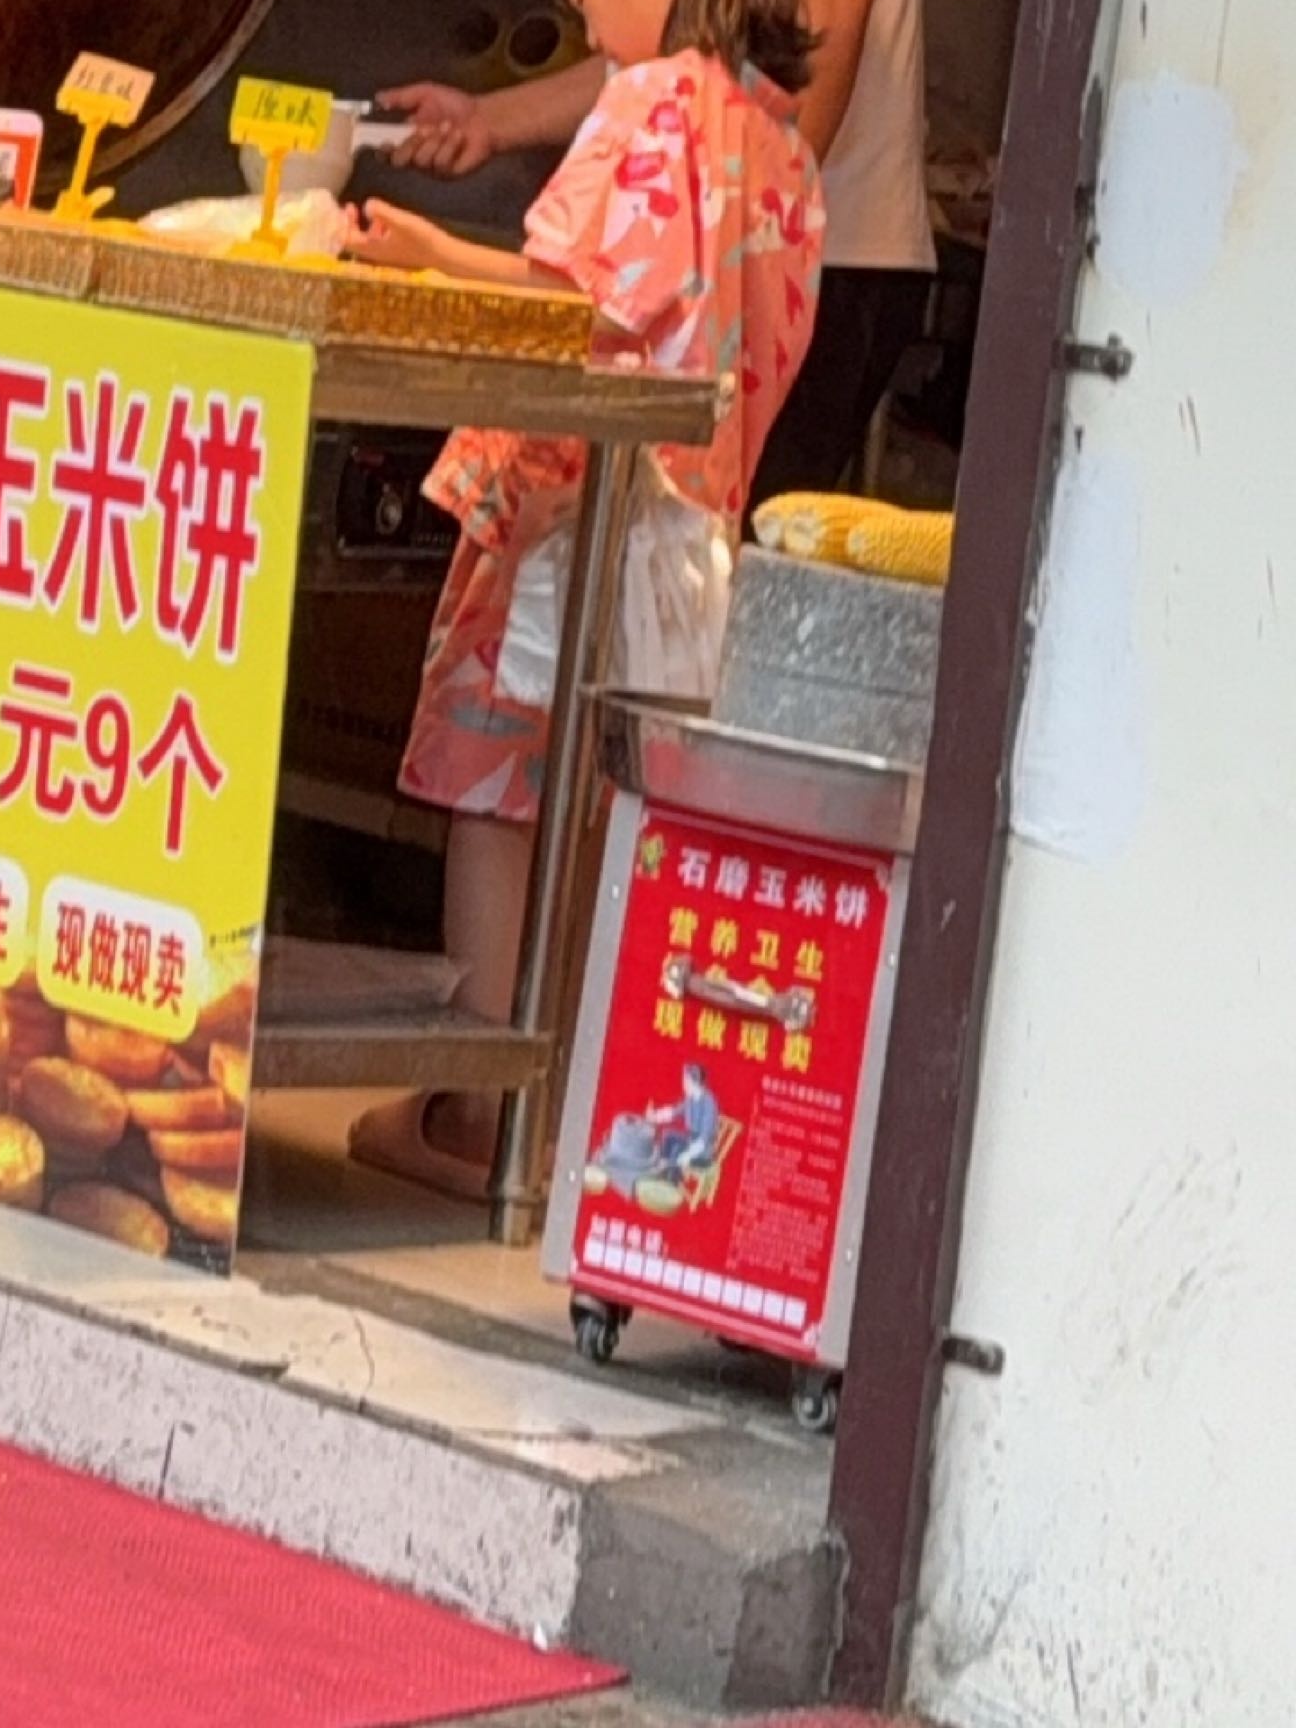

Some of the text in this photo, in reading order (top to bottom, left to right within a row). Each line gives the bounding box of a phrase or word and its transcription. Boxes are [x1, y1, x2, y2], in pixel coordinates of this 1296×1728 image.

[677, 846, 870, 930] 石磨玉米饼
[52, 901, 188, 1017] 现做现卖
[668, 905, 825, 983] 营养卫生
